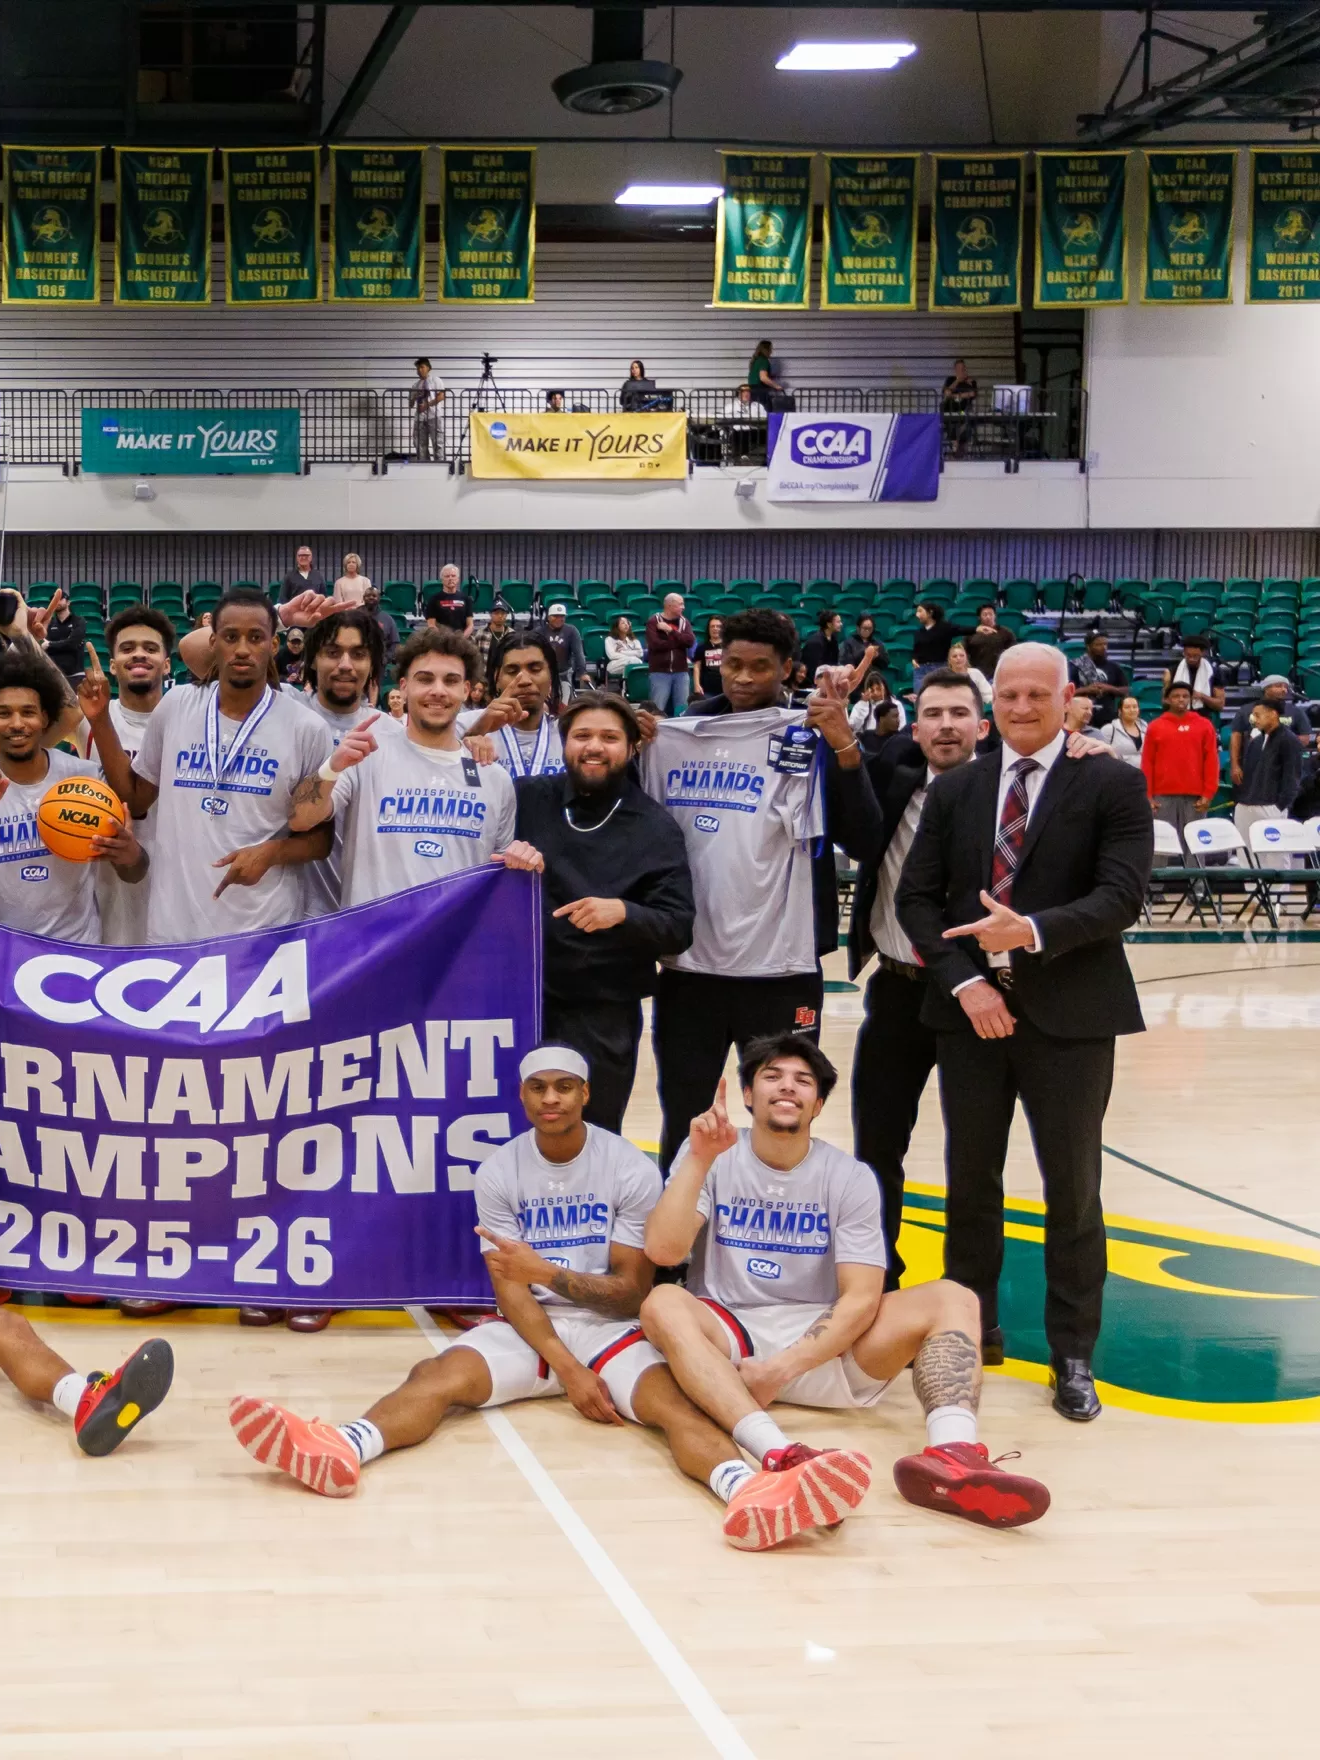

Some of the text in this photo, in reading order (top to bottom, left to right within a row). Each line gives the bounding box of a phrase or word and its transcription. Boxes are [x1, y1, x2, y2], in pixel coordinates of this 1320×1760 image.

[1258, 268, 1320, 281] BASKETBAL
[116, 420, 278, 458] MAKE IT YOURS
[506, 425, 664, 462] MAKE IT YOURS
[796, 429, 866, 456] CCAA
[802, 456, 859, 464] CHAMPIONSHIPS
[682, 760, 757, 773] UNDISPUTED
[778, 760, 808, 770] PARTICIPANT
[396, 788, 477, 800] UNDISPUTED
[666, 769, 765, 804] CHAMPS
[58, 783, 113, 808] Wilson
[58, 808, 101, 828] NCAA
[378, 796, 487, 830] CHAMPS
[696, 816, 719, 830] CCAA
[436, 828, 478, 838] CHAMPIONS
[417, 842, 442, 854] CCAA
[22, 868, 47, 877] CCAA
[12, 938, 311, 1034] CCAA
[519, 1193, 594, 1208] NDISPUTD
[731, 1196, 819, 1212] UNDISPUTED
[716, 1204, 830, 1246] CHAMPS
[750, 1260, 780, 1276] CCAA
